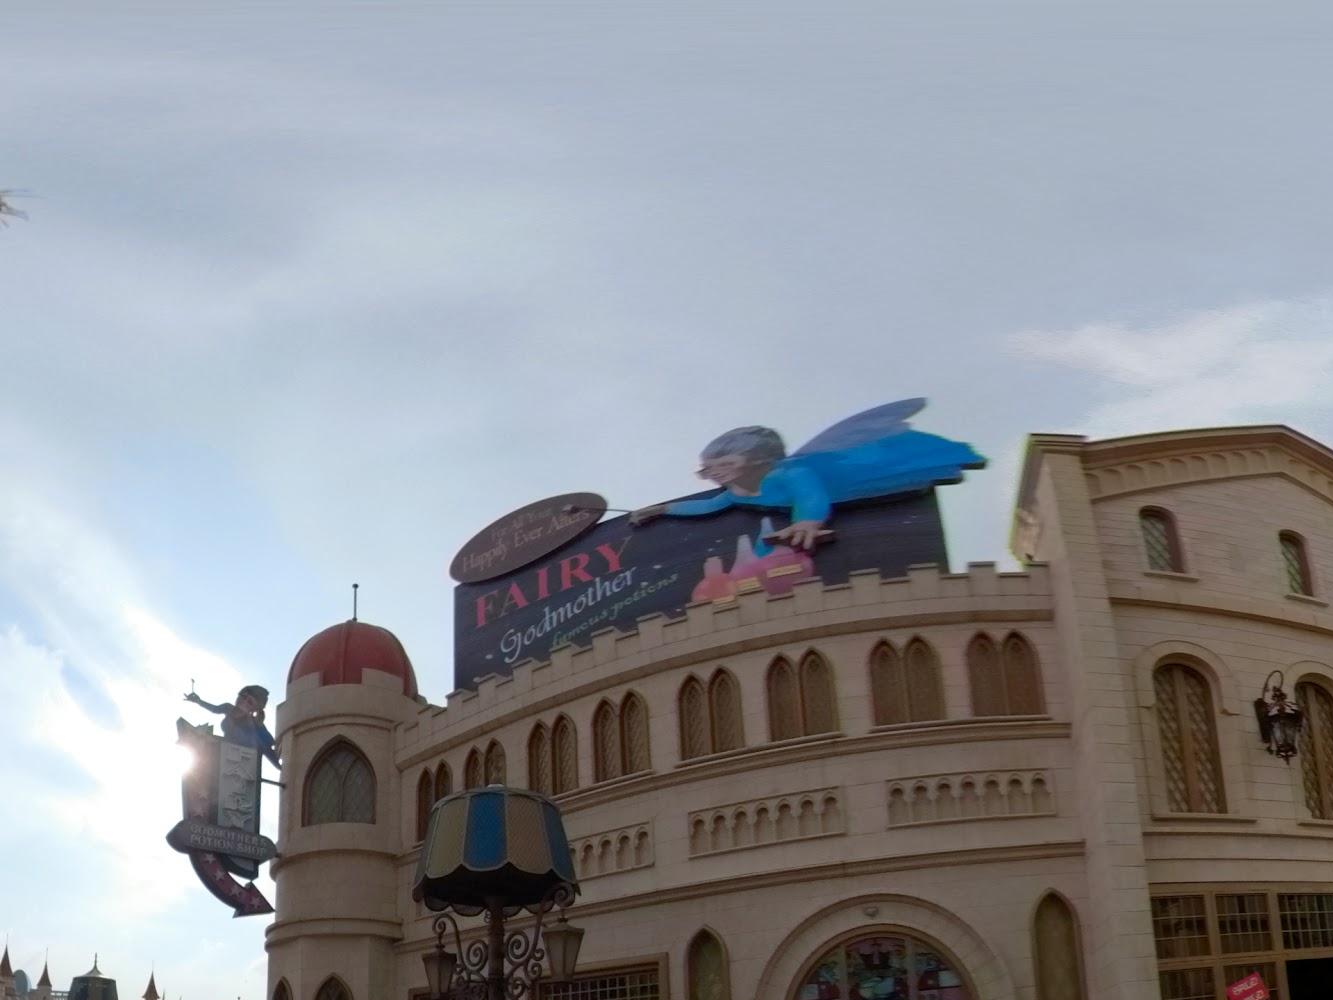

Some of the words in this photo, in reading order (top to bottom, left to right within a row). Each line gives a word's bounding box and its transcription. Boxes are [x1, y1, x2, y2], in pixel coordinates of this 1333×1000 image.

[513, 527, 544, 548] Ever
[474, 535, 632, 629] FAIRY
[500, 566, 637, 664] Godmother
[190, 834, 234, 850] POTION
[236, 843, 267, 857] SHOP
